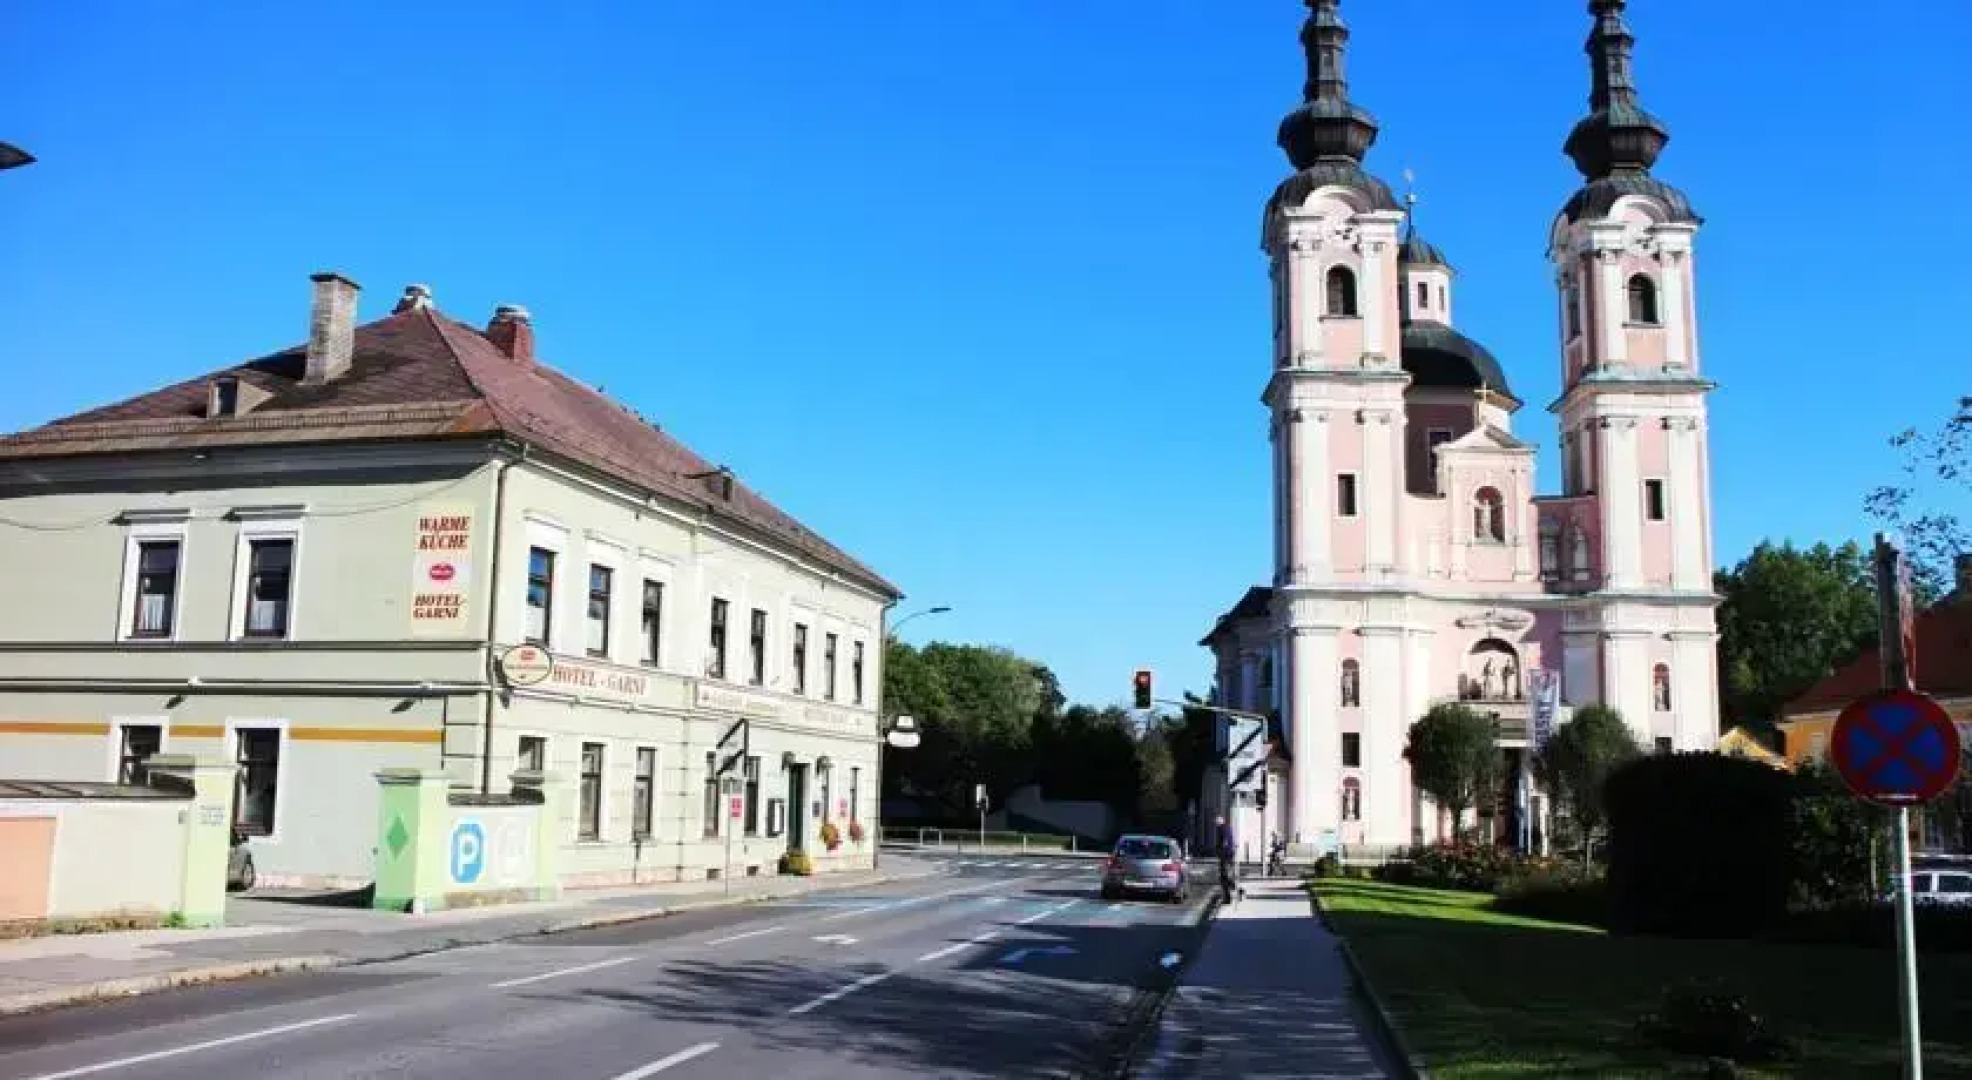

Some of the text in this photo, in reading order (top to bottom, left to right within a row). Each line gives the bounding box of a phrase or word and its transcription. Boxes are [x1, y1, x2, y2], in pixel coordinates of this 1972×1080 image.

[418, 516, 471, 531] WARME
[417, 531, 470, 549] KÜCHE
[414, 594, 467, 606] HOTEL-
[413, 607, 459, 618] GARNI
[553, 663, 597, 688] HOTEL
[607, 674, 647, 696] GARNI
